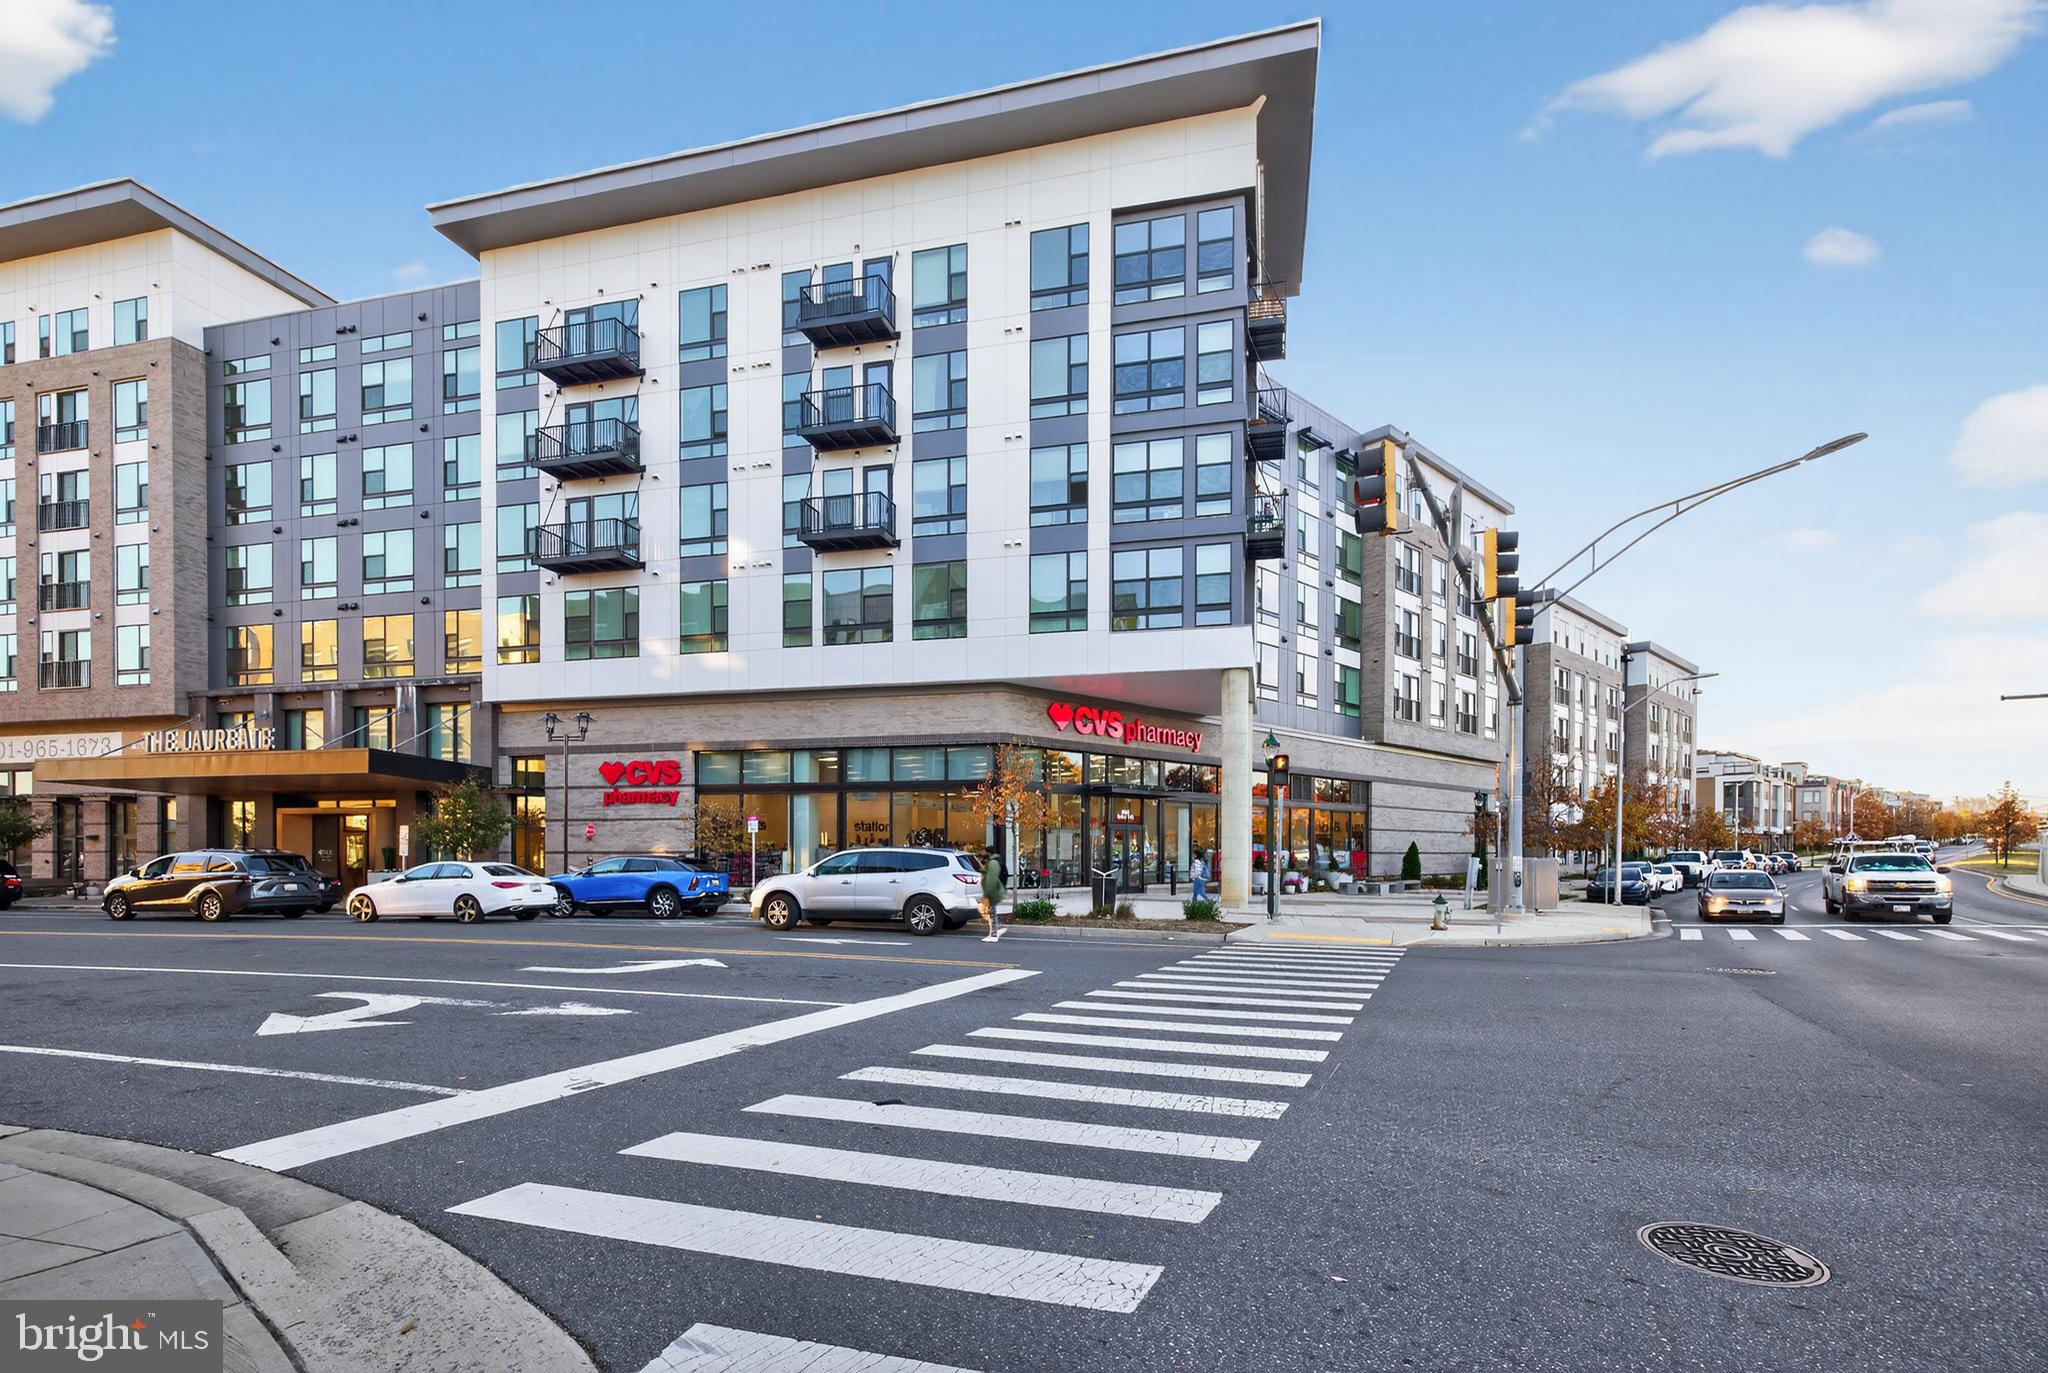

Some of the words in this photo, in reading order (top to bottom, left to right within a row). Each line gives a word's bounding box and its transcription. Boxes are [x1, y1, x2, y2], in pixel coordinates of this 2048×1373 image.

[1074, 706, 1124, 739] CVS
[1124, 719, 1203, 752] pharmacy
[144, 730, 179, 753] THE
[625, 760, 682, 785] CVS
[603, 787, 680, 807] pharmacy
